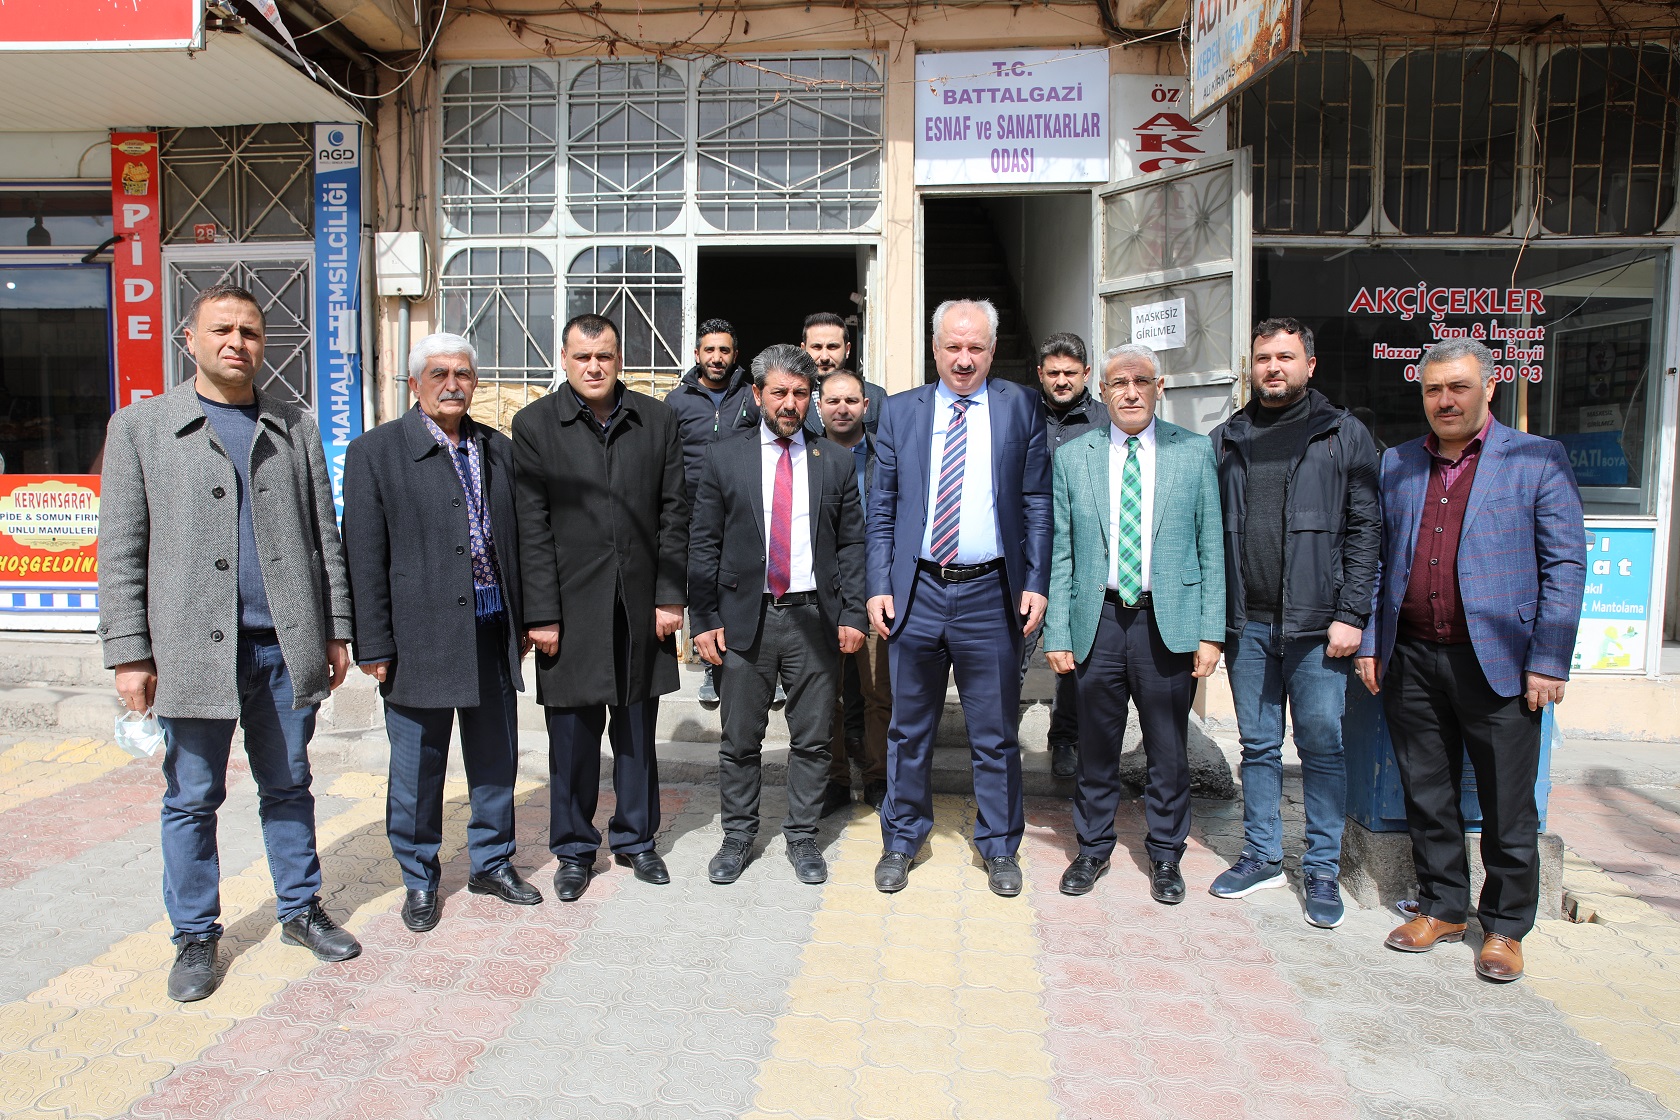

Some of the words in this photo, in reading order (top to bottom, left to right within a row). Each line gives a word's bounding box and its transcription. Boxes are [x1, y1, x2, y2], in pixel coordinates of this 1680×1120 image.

[992, 61, 1033, 77] T.C.
[943, 82, 1083, 105] BATTALGAZİ
[1151, 84, 1181, 103] ÖZ
[925, 116, 971, 141] ESNAF
[976, 120, 992, 140] ve
[997, 113, 1101, 140] SANATKARLAR
[319, 149, 355, 160] AGD
[990, 147, 1035, 173] ODASI
[197, 228, 214, 241] 28
[1348, 281, 1546, 320] AKÇİÇEKLER
[1135, 306, 1178, 325] MASKESİZ
[1135, 325, 1176, 340] GİRİLMEZ
[1471, 323, 1487, 340] &
[1490, 319, 1546, 344] İnşaat
[1373, 342, 1422, 360] Hazar
[1506, 344, 1545, 364] Bayii
[1519, 364, 1543, 384] 93
[1602, 456, 1626, 467] BOYA
[14, 492, 92, 510] KERVANSARAY
[0, 511, 22, 521] PİDE
[25, 513, 33, 521] &
[36, 513, 72, 521] SOMUN
[8, 526, 36, 534] UNLU
[38, 525, 97, 535] MAMULLERİ
[1591, 599, 1644, 614] Mantolama
